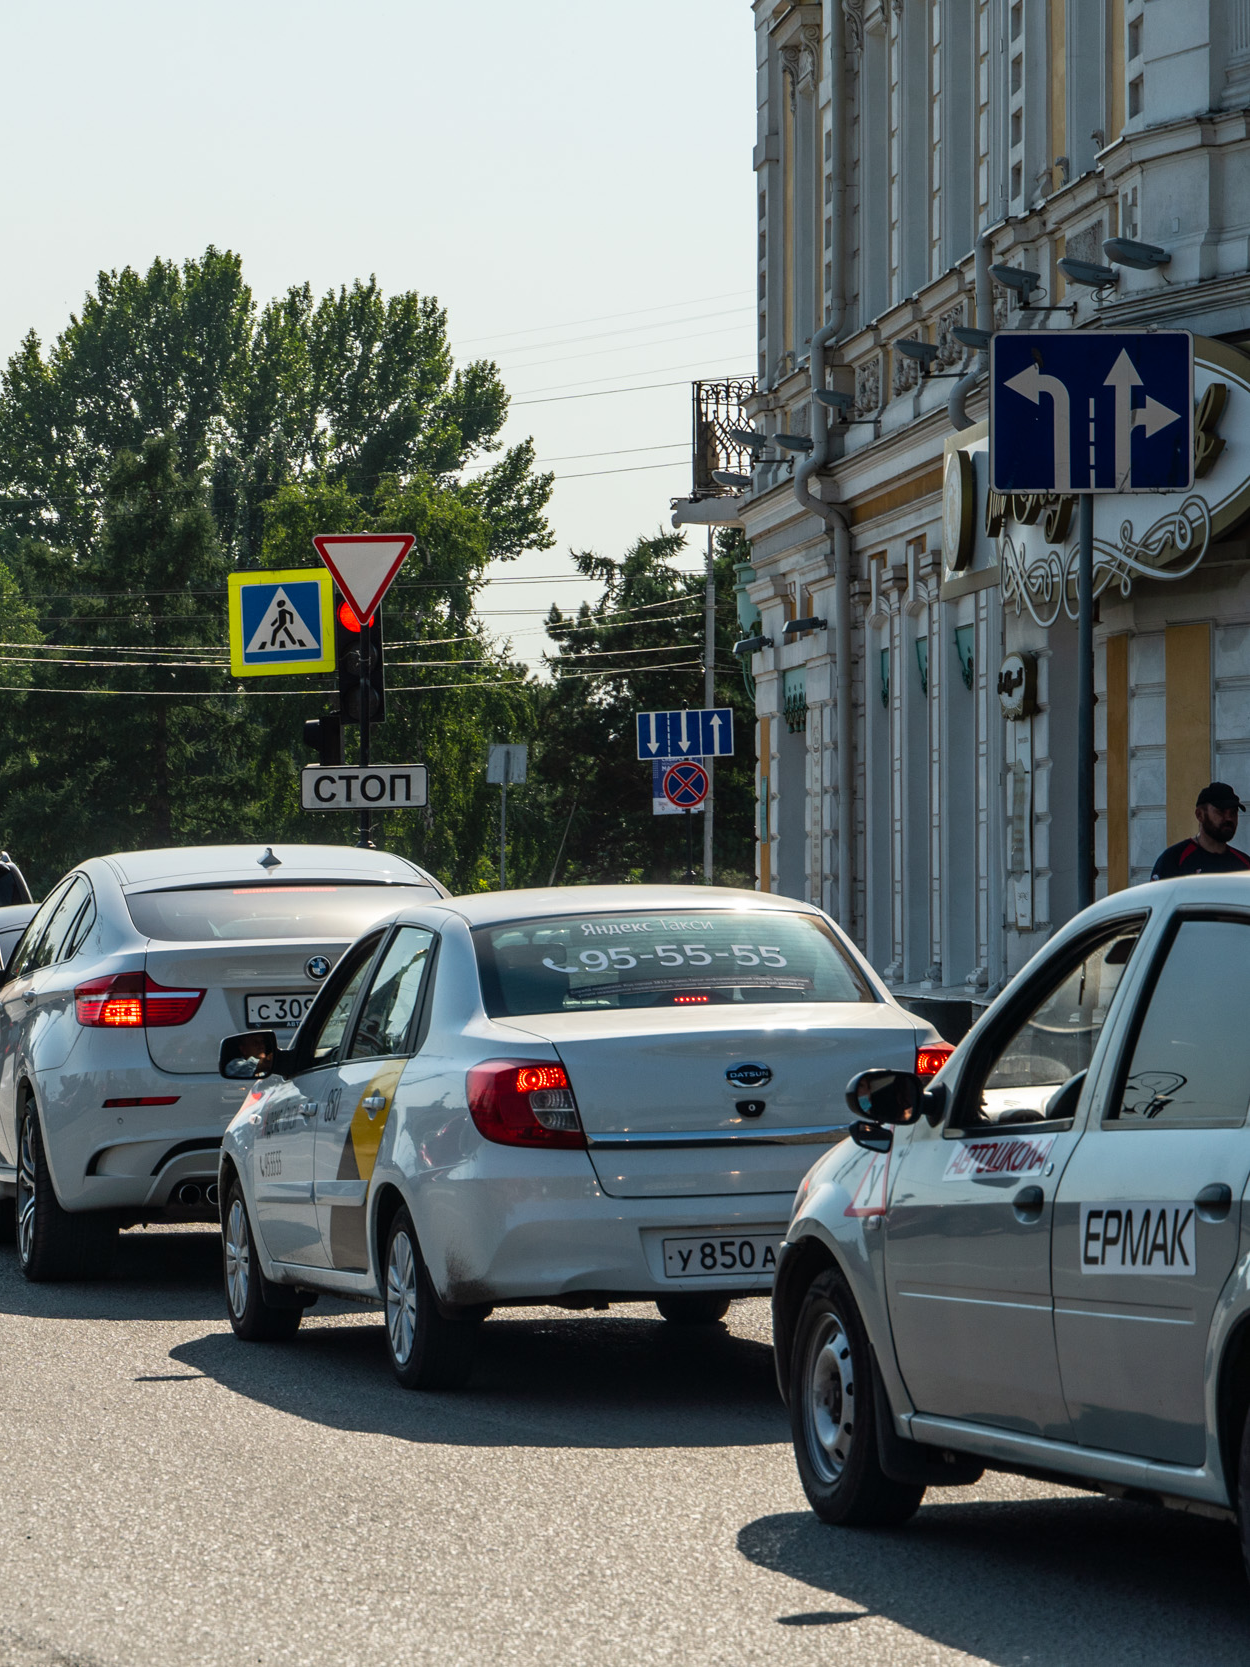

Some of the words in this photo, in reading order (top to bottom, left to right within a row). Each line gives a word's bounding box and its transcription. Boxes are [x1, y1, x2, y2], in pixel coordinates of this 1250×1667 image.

[314, 774, 412, 803] СТОП
[581, 922, 653, 937] Яндекс
[658, 919, 714, 931] Такси
[579, 944, 788, 973] 95-55-55
[729, 1070, 769, 1079] DATSUN
[946, 1139, 1054, 1175] АВТОШКОЛА
[1083, 1207, 1195, 1267] ЕРМАК
